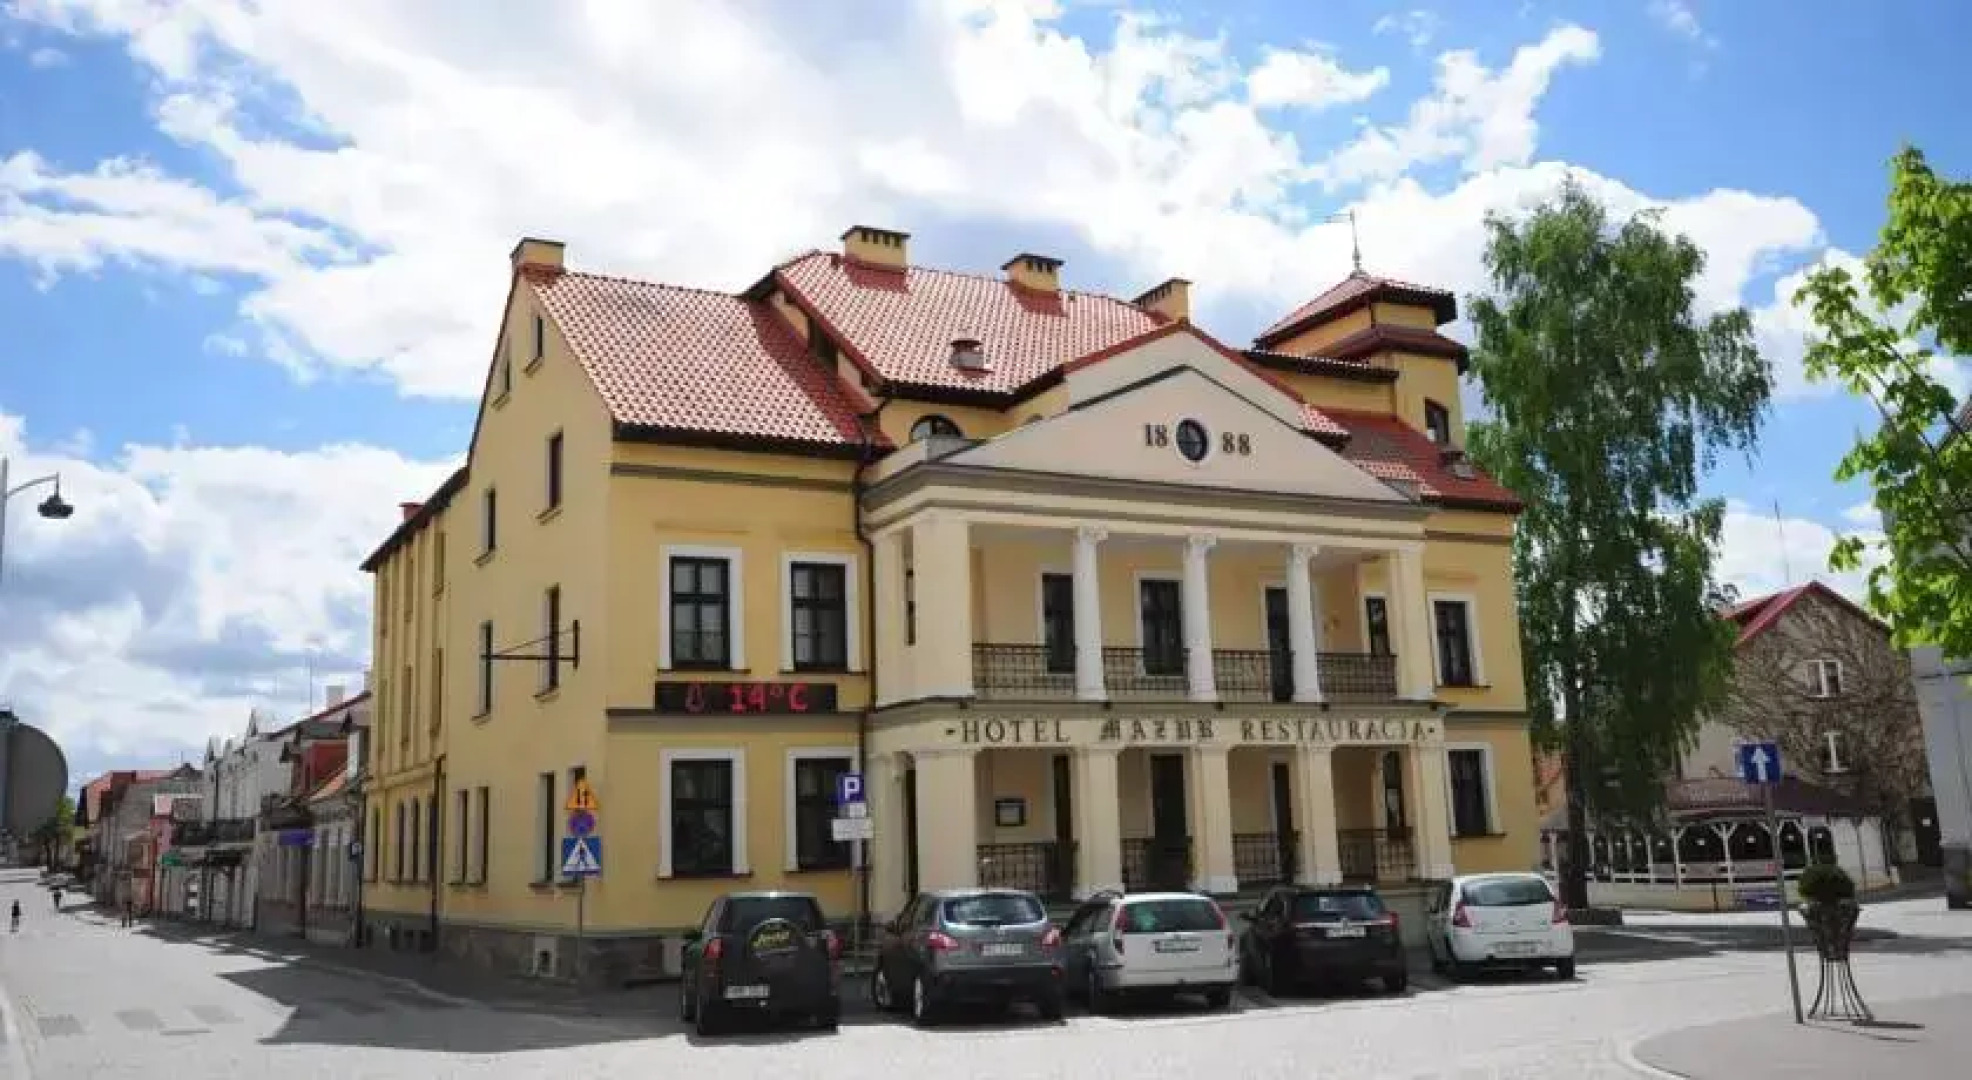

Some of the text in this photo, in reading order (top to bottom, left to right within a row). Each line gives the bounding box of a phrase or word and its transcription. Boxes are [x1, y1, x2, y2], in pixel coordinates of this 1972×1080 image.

[1145, 424, 1251, 455] 18 88
[962, 719, 1071, 743] HOTEL
[1241, 719, 1427, 742] RESTAURACJA
[844, 776, 860, 800] P
